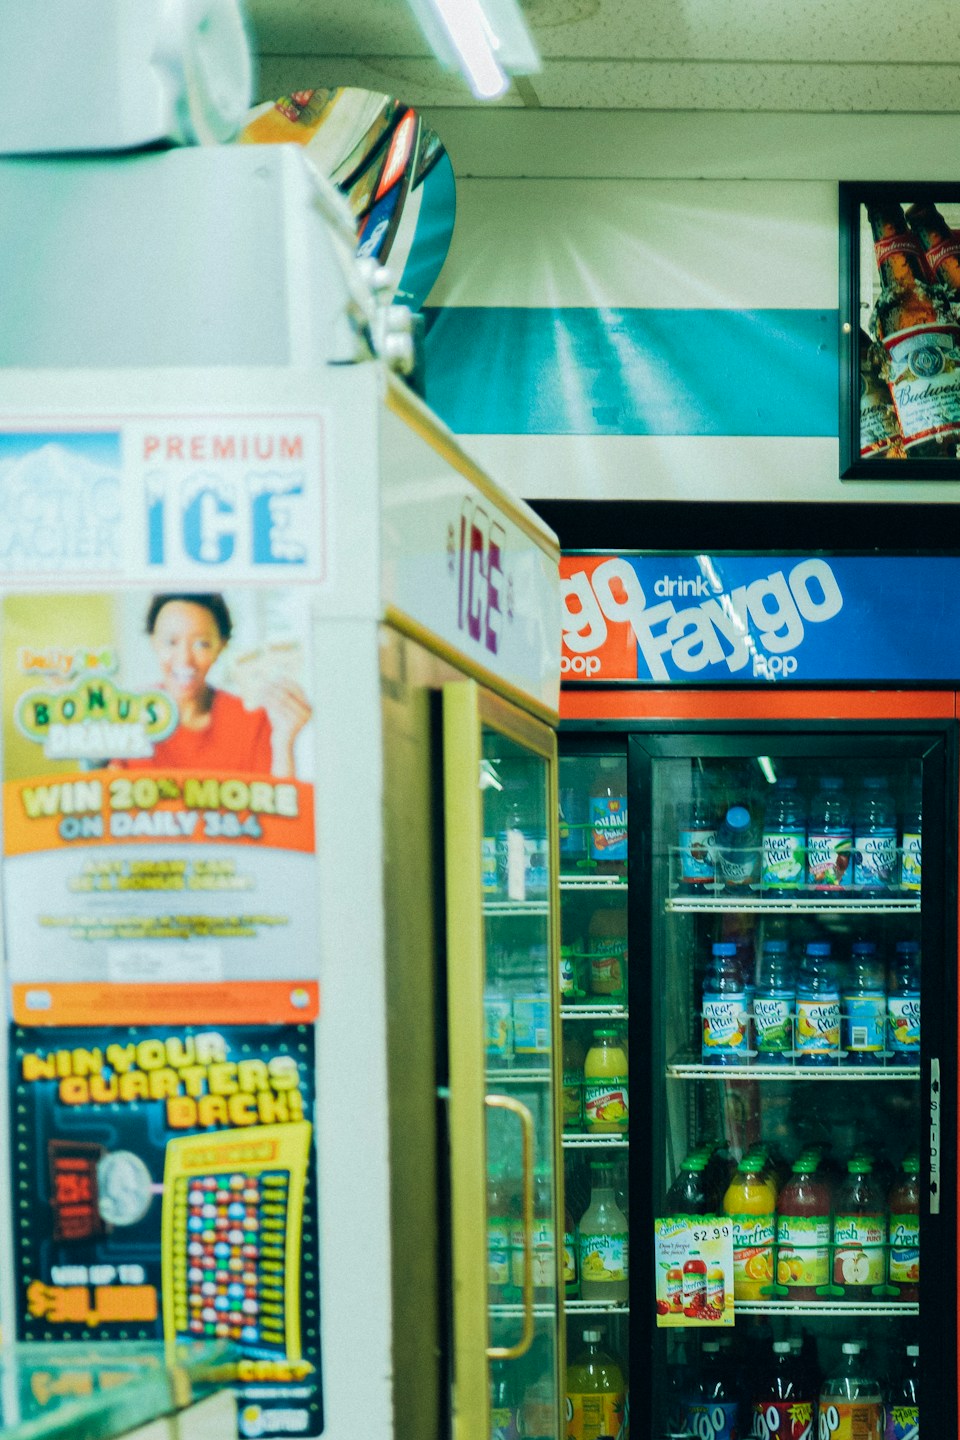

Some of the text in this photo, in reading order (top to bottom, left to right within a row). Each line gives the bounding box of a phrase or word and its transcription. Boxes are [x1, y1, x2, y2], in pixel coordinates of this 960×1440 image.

[143, 434, 304, 461] PREMIUM
[143, 470, 307, 566] ICE
[456, 495, 507, 656] ICE
[654, 575, 710, 597] drink
[629, 558, 844, 681] Faygo
[33, 685, 158, 727] BONUS
[22, 779, 102, 818] WIN
[183, 779, 298, 817] MORE
[59, 814, 103, 839] ON
[110, 811, 199, 836] DAILY
[865, 838, 894, 851] Clear
[767, 850, 792, 866] fruit
[705, 1003, 733, 1016] Clear
[754, 1002, 783, 1016] Clear
[810, 1005, 840, 1019] Clear
[901, 1002, 921, 1017] Cle
[709, 1012, 734, 1031] fruit
[23, 1031, 228, 1081] WIN YOUR
[59, 1055, 300, 1104] QUARTERS
[167, 1089, 303, 1128] BACK!
[660, 1219, 688, 1236] Everfresh
[834, 1223, 858, 1241] fresh
